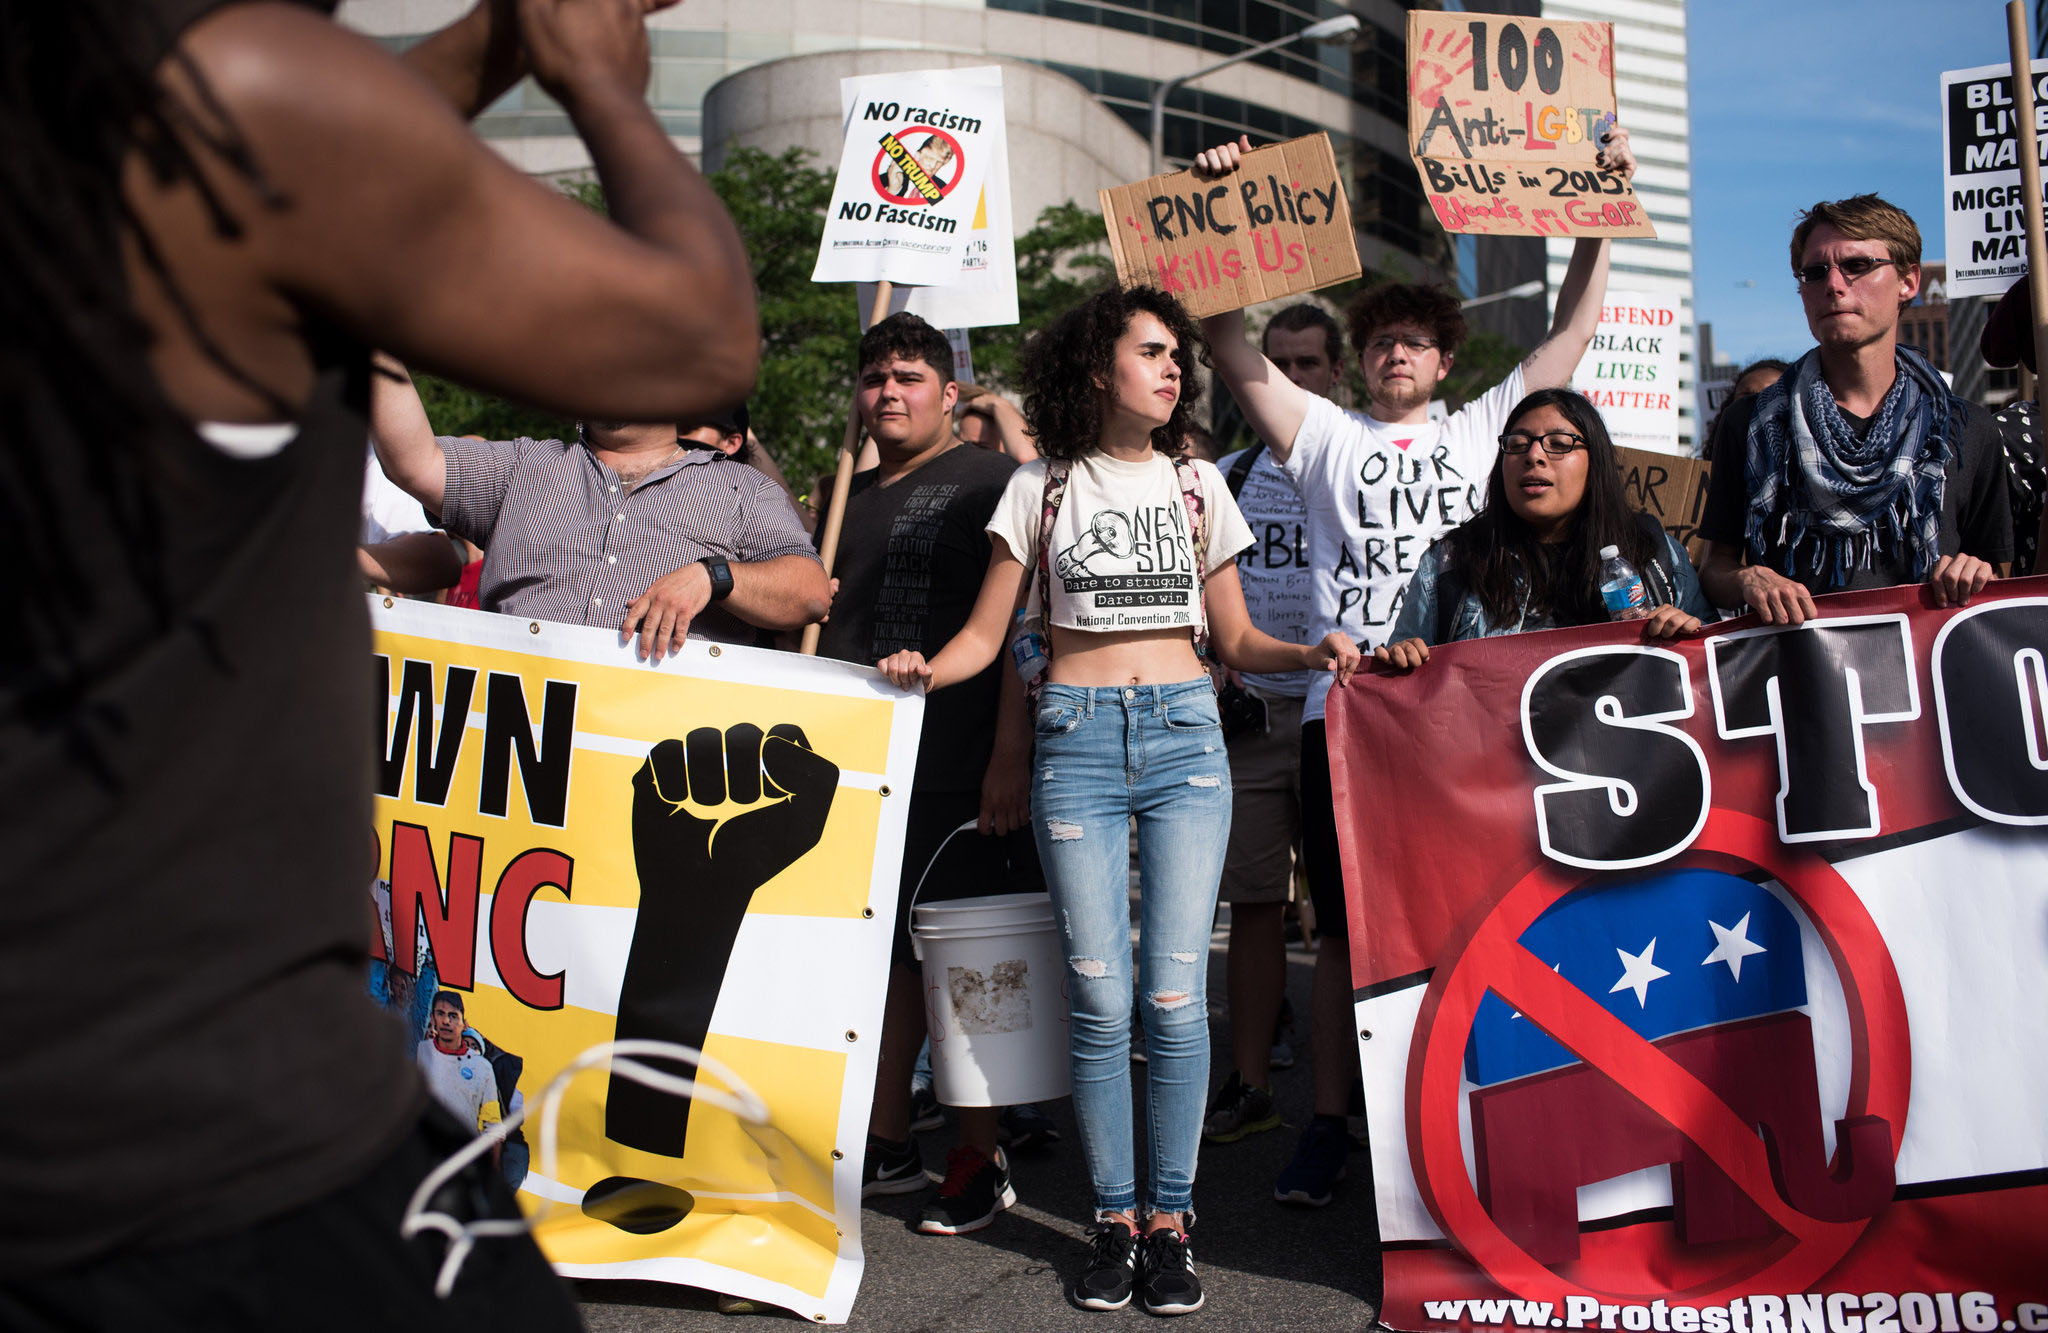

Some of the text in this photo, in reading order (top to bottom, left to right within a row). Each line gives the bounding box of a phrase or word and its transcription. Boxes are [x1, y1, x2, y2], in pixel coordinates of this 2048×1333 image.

[1469, 21, 1564, 95] 100
[864, 102, 982, 134] NO racism
[882, 135, 941, 200] NO TRUMP
[1421, 157, 1506, 195] Bills
[1517, 171, 1541, 188] in
[838, 202, 957, 234] NO Fascism
[1147, 174, 1337, 242] RNC Policy
[1428, 194, 1523, 230] Blood's
[1156, 226, 1305, 294] Kills Us
[1599, 306, 1674, 327] EFEND
[1592, 334, 1663, 354] BLACK
[1596, 362, 1657, 382] LIVES
[1582, 389, 1672, 410] MATTER
[1360, 445, 1464, 486] OUR
[1135, 501, 1186, 542] NEW
[887, 537, 937, 556] GRATIOT
[1335, 535, 1416, 582] ARE
[886, 556, 931, 572] MACK
[1065, 575, 1192, 591] Dare to struggle,
[1098, 593, 1189, 605] Dare to win.
[1076, 611, 1190, 627] National Convention 2015
[368, 819, 575, 1011] NC
